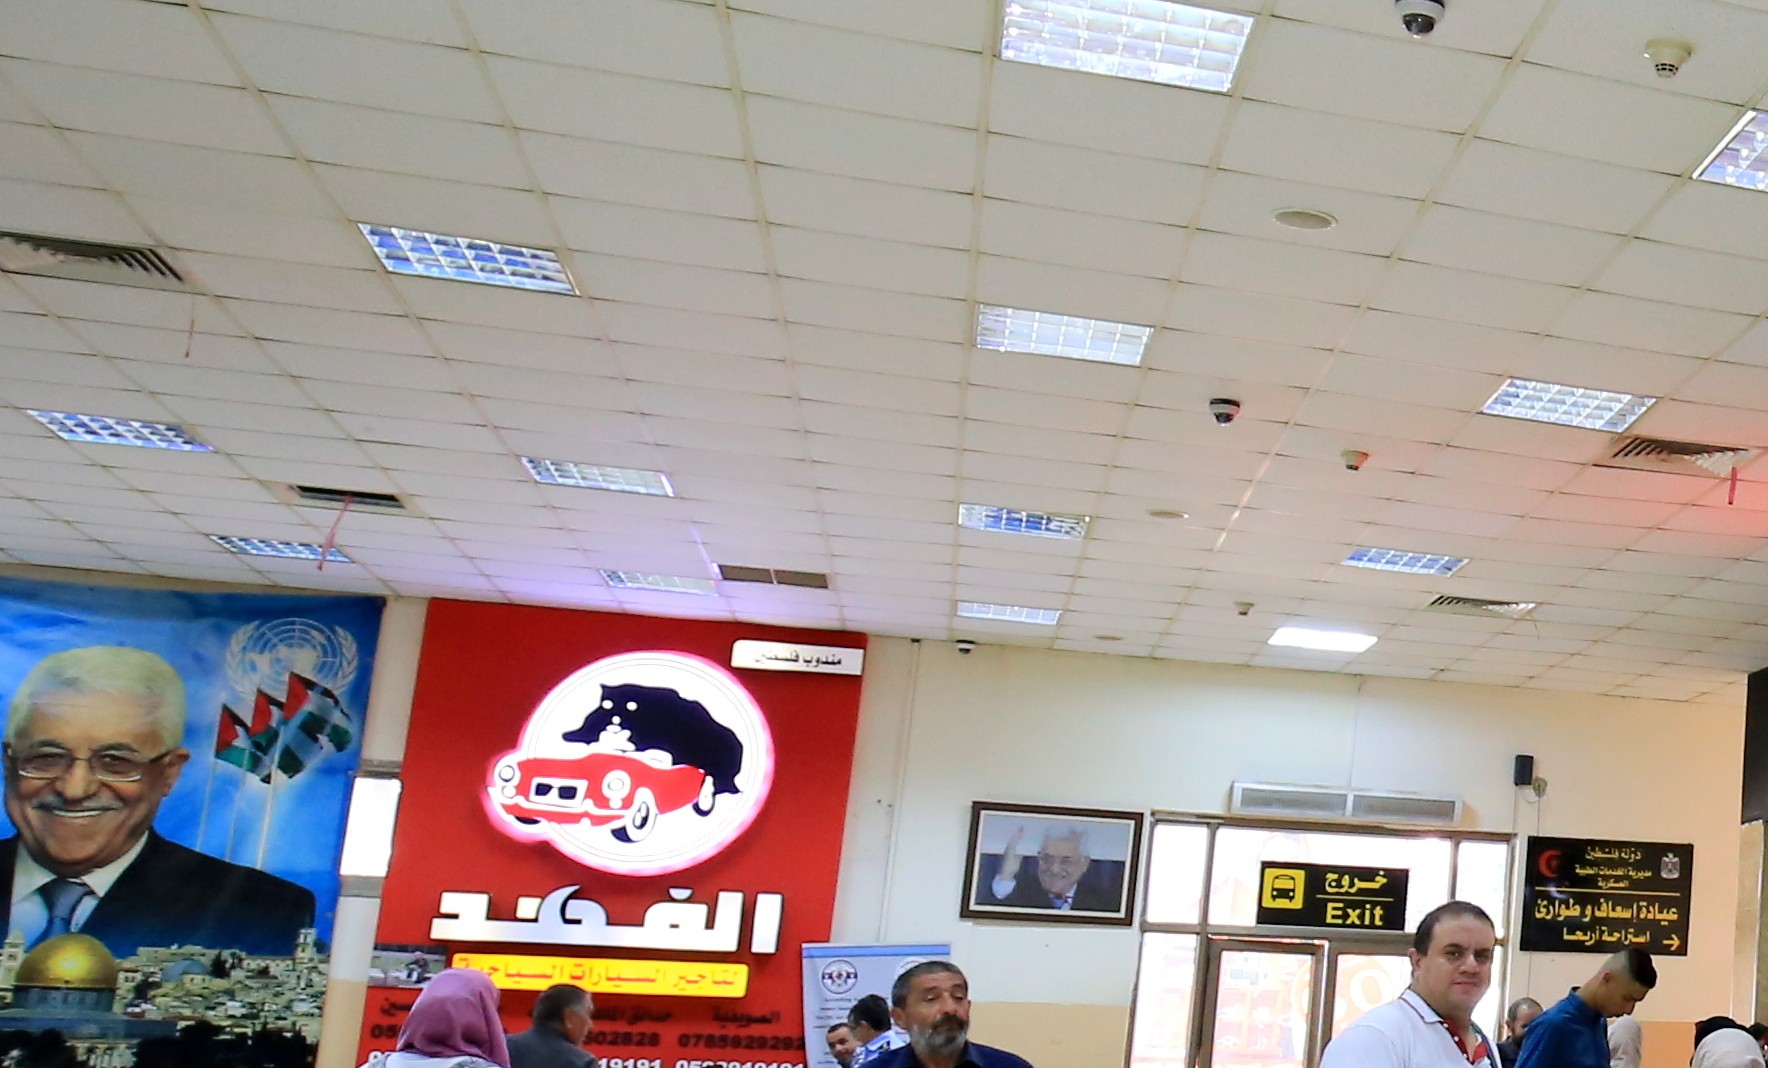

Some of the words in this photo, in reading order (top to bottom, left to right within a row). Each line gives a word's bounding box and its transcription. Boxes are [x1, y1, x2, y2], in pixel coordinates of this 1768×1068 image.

[802, 653, 842, 668] مندوب
[1585, 846, 1619, 860] فلسطين
[1621, 848, 1642, 862] دولة
[1325, 870, 1388, 893] خروج
[1325, 902, 1384, 926] Exit
[1535, 897, 1580, 921] طوارئ
[1582, 903, 1592, 921] و
[1594, 898, 1637, 922] إسعاف
[1640, 901, 1679, 925] عيادة
[1601, 926, 1650, 945] استراحة
